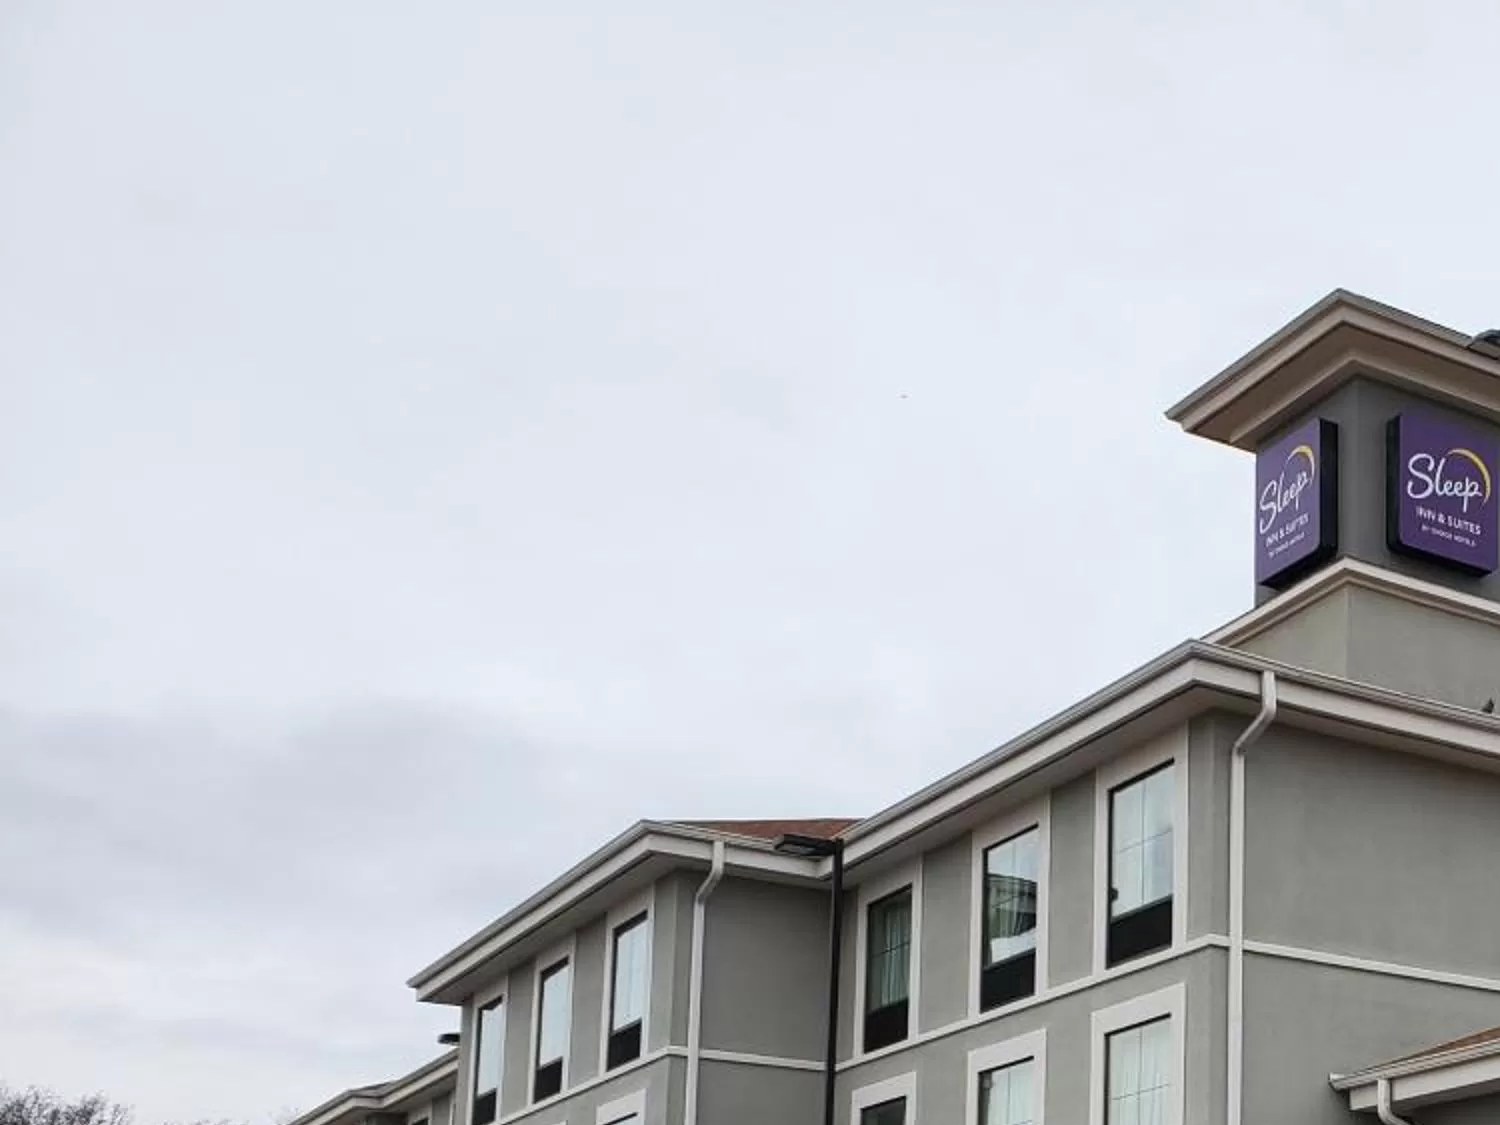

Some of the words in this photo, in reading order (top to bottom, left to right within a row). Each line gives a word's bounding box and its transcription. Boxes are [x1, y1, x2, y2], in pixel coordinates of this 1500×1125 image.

[1260, 471, 1308, 534] Sleep
[1407, 453, 1483, 512] Sleep
[1447, 515, 1481, 535] SUITES
